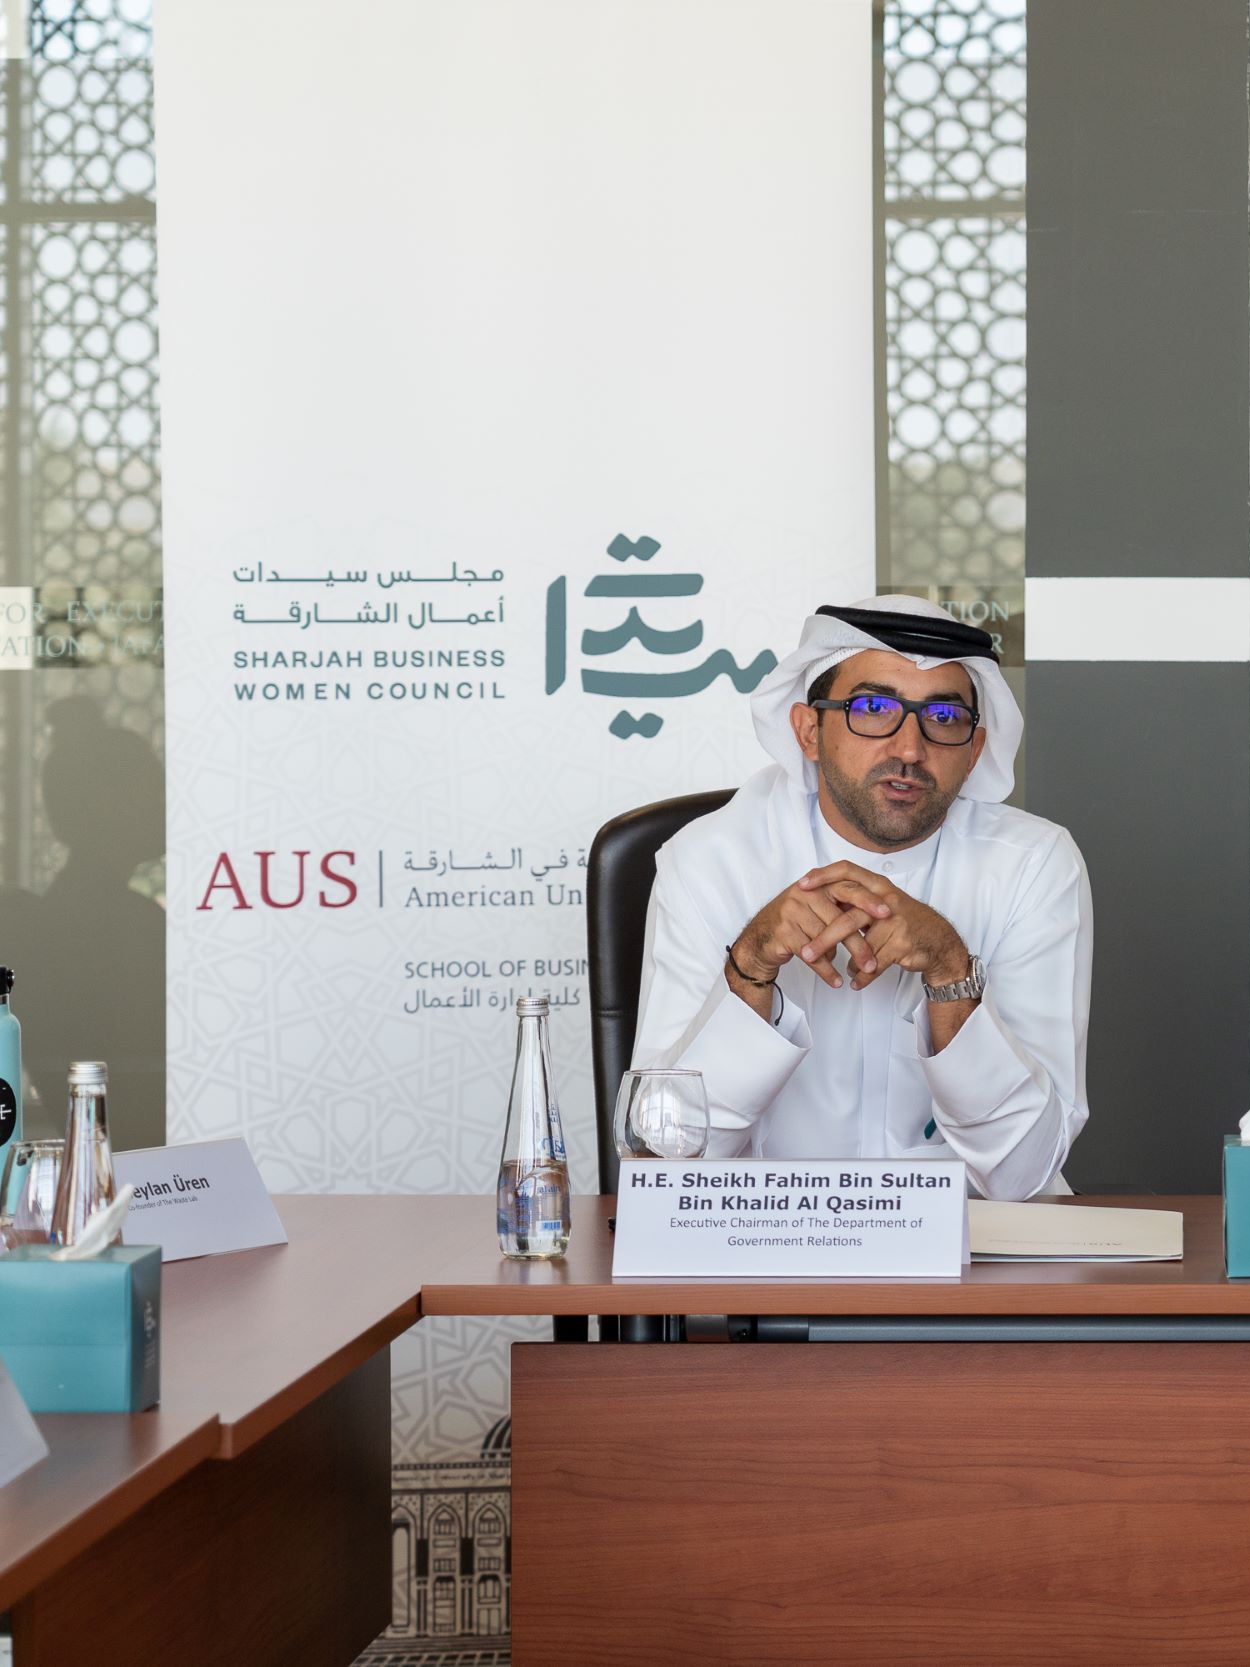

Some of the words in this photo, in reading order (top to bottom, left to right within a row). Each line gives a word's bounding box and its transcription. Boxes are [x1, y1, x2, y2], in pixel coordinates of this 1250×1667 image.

[232, 561, 368, 588] سيدات
[376, 561, 505, 589] مجلس
[0, 601, 46, 624] OR
[233, 601, 398, 630] الشارقة
[407, 595, 504, 630] أعمال
[233, 650, 363, 669] SHARJAH
[373, 649, 505, 668] BUSINESS
[233, 682, 351, 701] WOMEN
[366, 681, 506, 701] COUNCIL
[403, 847, 523, 877] الشارقة
[530, 849, 569, 882] في
[195, 850, 358, 911] AUS
[404, 885, 535, 908] American
[404, 960, 493, 980] SCHOOL
[498, 959, 527, 978] OF
[403, 986, 481, 1015] الأعمال
[131, 1182, 172, 1200] eylan
[173, 1174, 210, 1192] Üren
[631, 1172, 674, 1188] H.E.
[681, 1172, 756, 1188] Sheikh
[764, 1172, 830, 1188] Fahim
[839, 1172, 873, 1188] Bin
[880, 1172, 951, 1189] Sultan
[678, 1195, 713, 1211] Bin
[721, 1195, 790, 1211] Khalid
[796, 1195, 818, 1211] Al
[826, 1195, 902, 1214] Qasimi
[670, 1217, 727, 1228] Executive
[730, 1217, 788, 1228] Chairman
[791, 1216, 805, 1228] of
[807, 1217, 830, 1228] The
[833, 1217, 907, 1231] Department
[910, 1217, 923, 1229] of
[727, 1235, 803, 1247] Government
[807, 1235, 863, 1247] Relations
